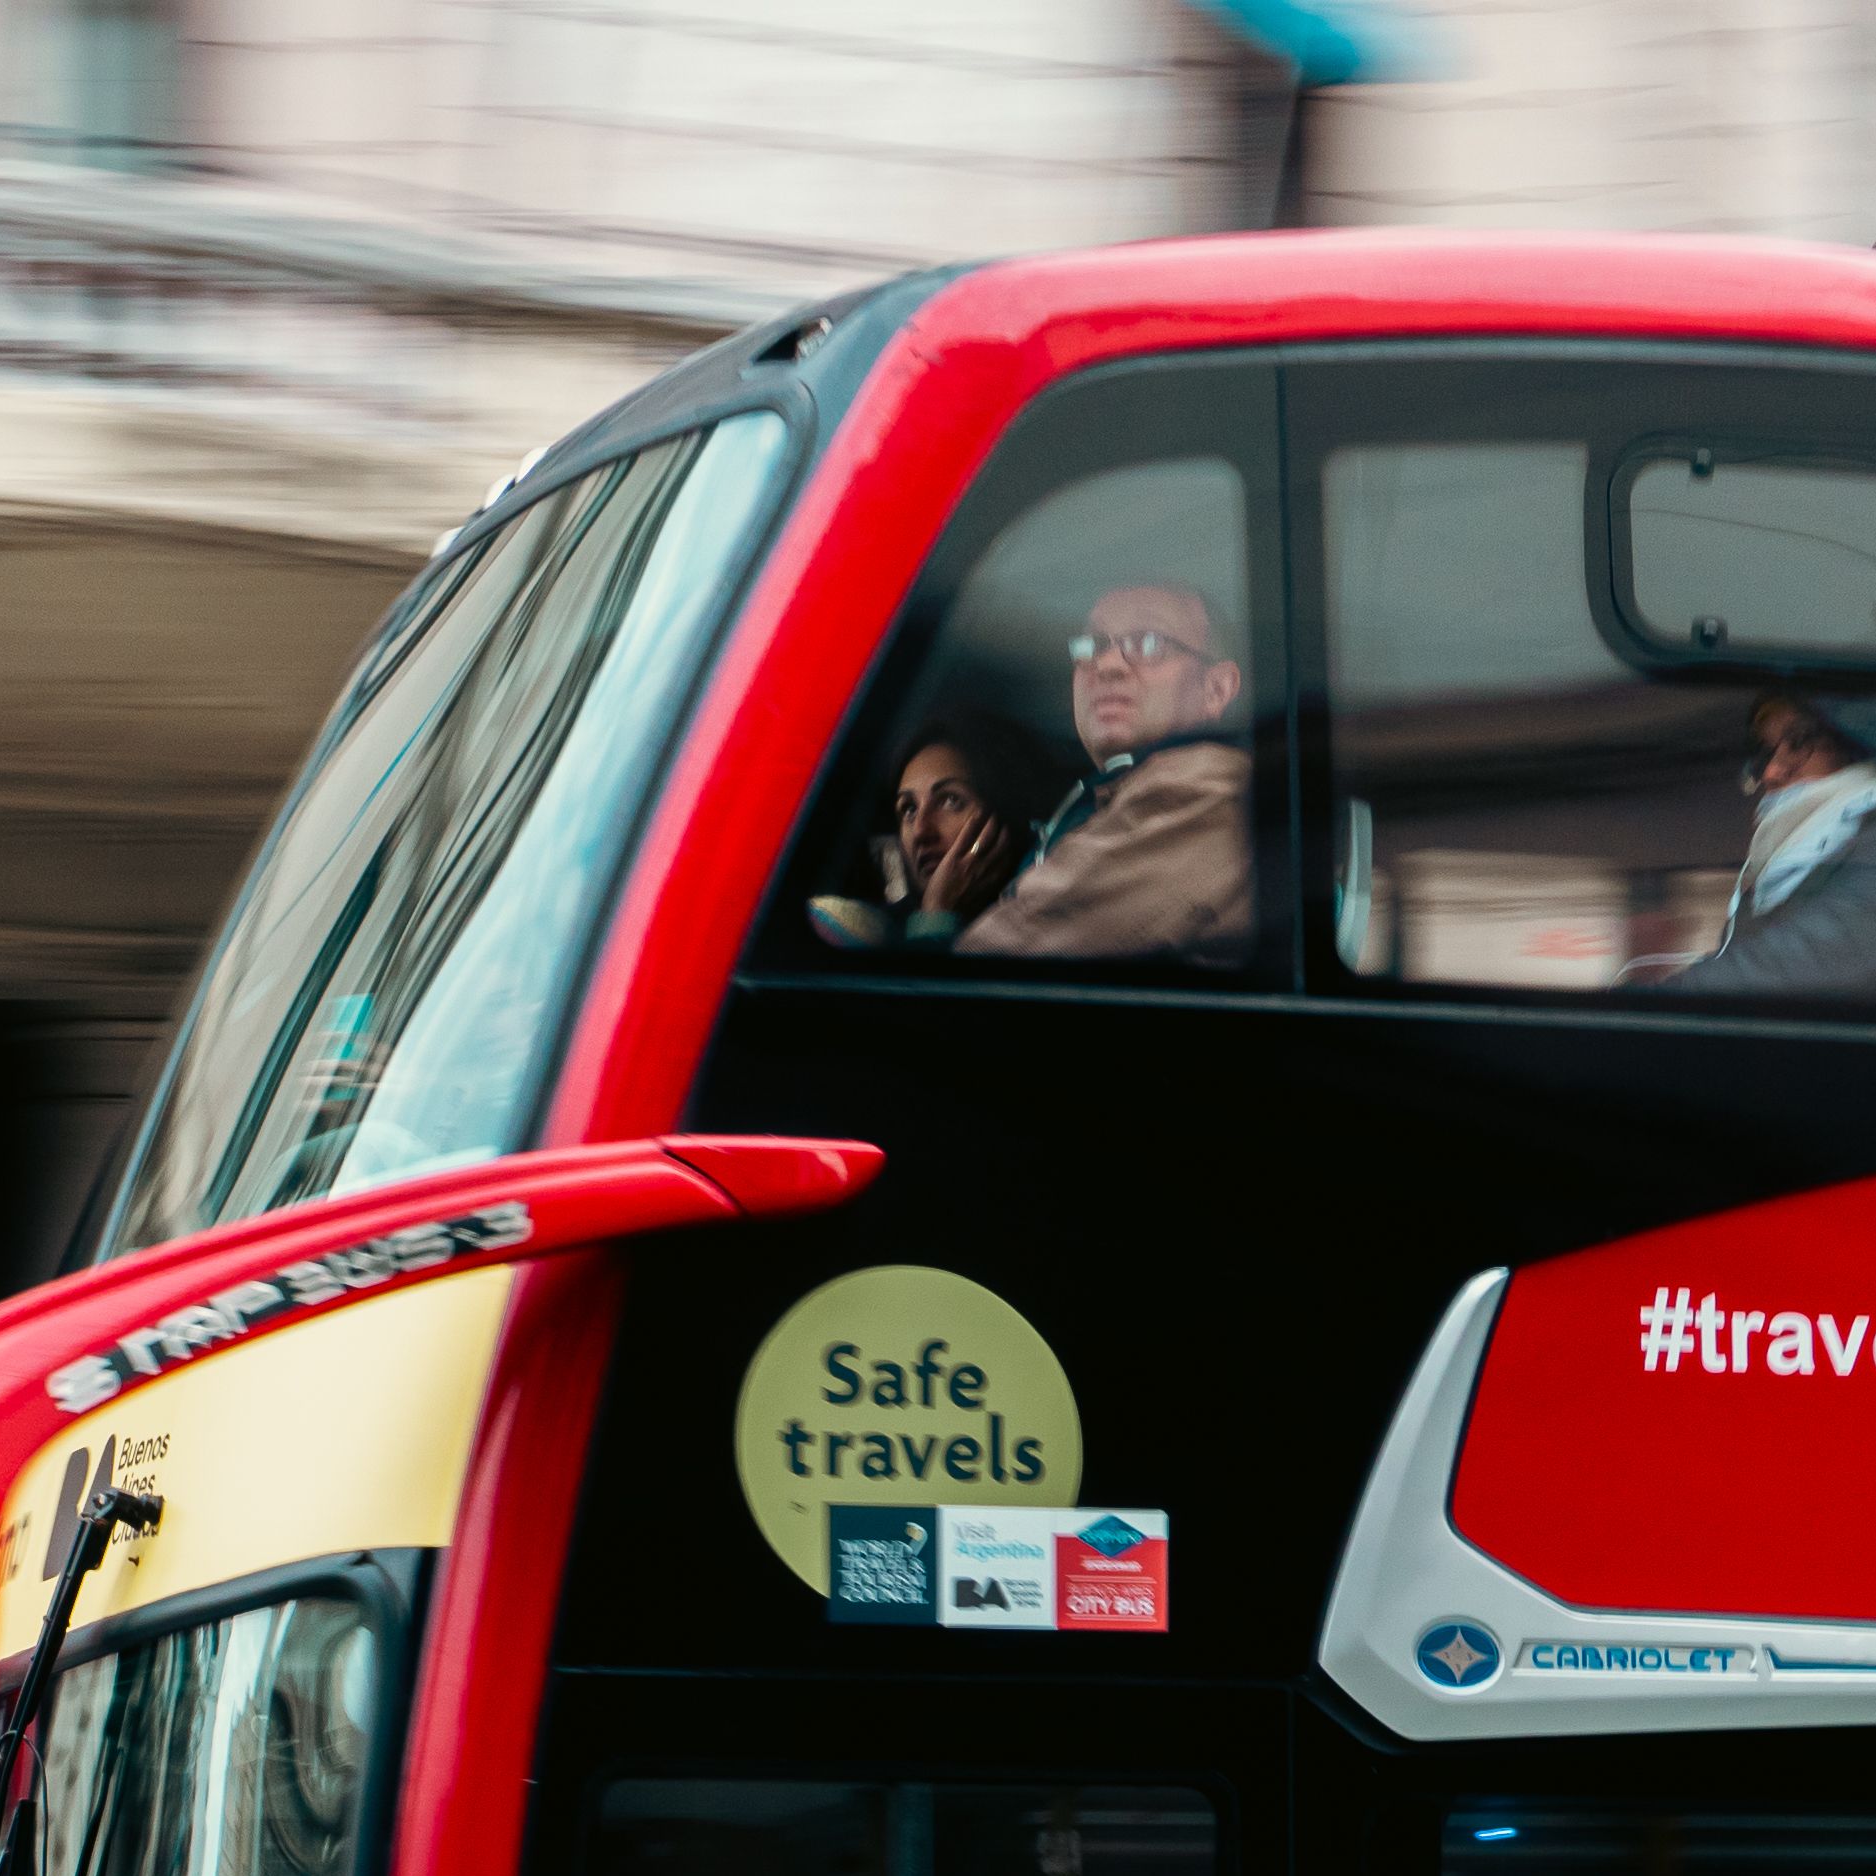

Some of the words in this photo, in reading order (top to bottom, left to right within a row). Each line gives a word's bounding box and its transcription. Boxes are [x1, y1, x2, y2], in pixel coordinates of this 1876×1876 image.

[820, 1338, 989, 1412] Safe
[118, 1433, 170, 1470] Buenos
[778, 1410, 1046, 1485] travels
[955, 1541, 1045, 1563] Argentina
[951, 1576, 1010, 1612] BA
[1066, 1595, 1113, 1614] CITY
[1112, 1596, 1156, 1616] BUS
[1531, 1643, 1736, 1673] CABRIOLET
